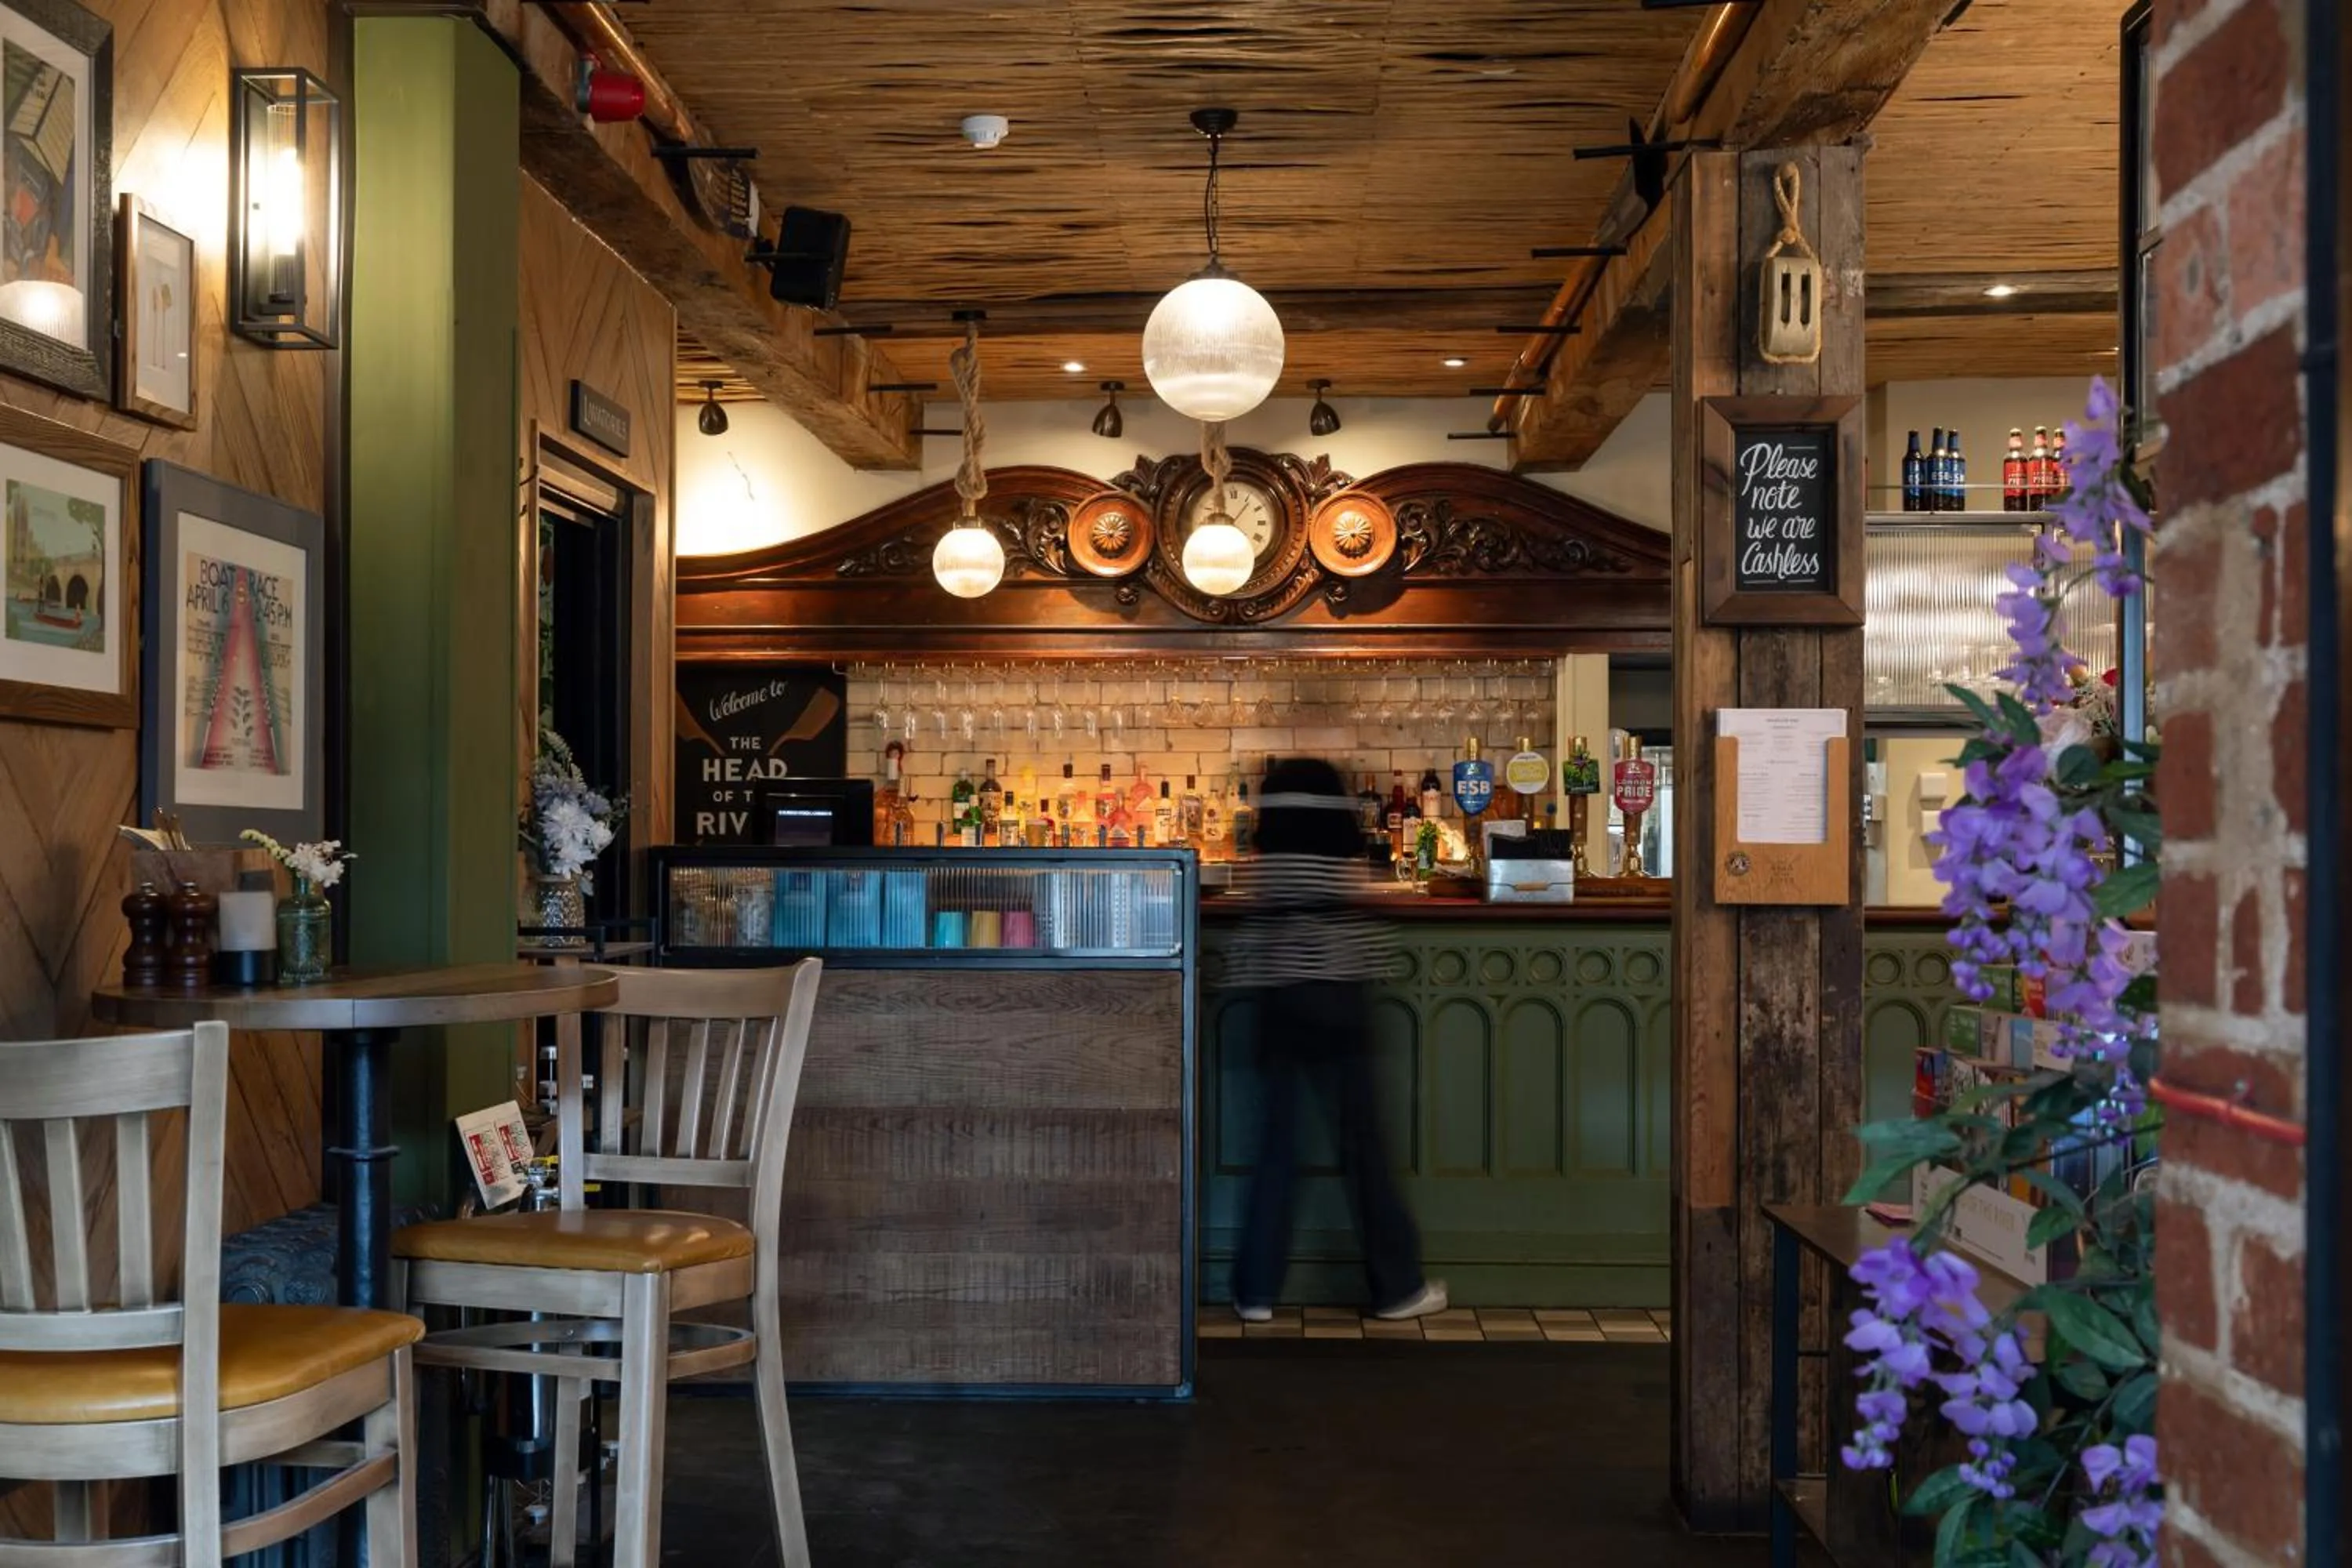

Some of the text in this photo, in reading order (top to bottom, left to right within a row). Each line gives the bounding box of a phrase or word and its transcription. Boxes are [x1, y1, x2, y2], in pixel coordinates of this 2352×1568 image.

[1740, 443, 1818, 495] Please
[1751, 480, 1802, 510] note
[1747, 515, 1816, 539] we are
[1741, 541, 1819, 579] Cashless
[710, 678, 787, 721] Welcome to
[730, 737, 761, 750] THE
[702, 758, 788, 782] HEAD
[713, 791, 734, 802] OF
[1458, 781, 1490, 794] ESB
[1616, 786, 1651, 797] PRIDE
[696, 812, 750, 837] RIV
